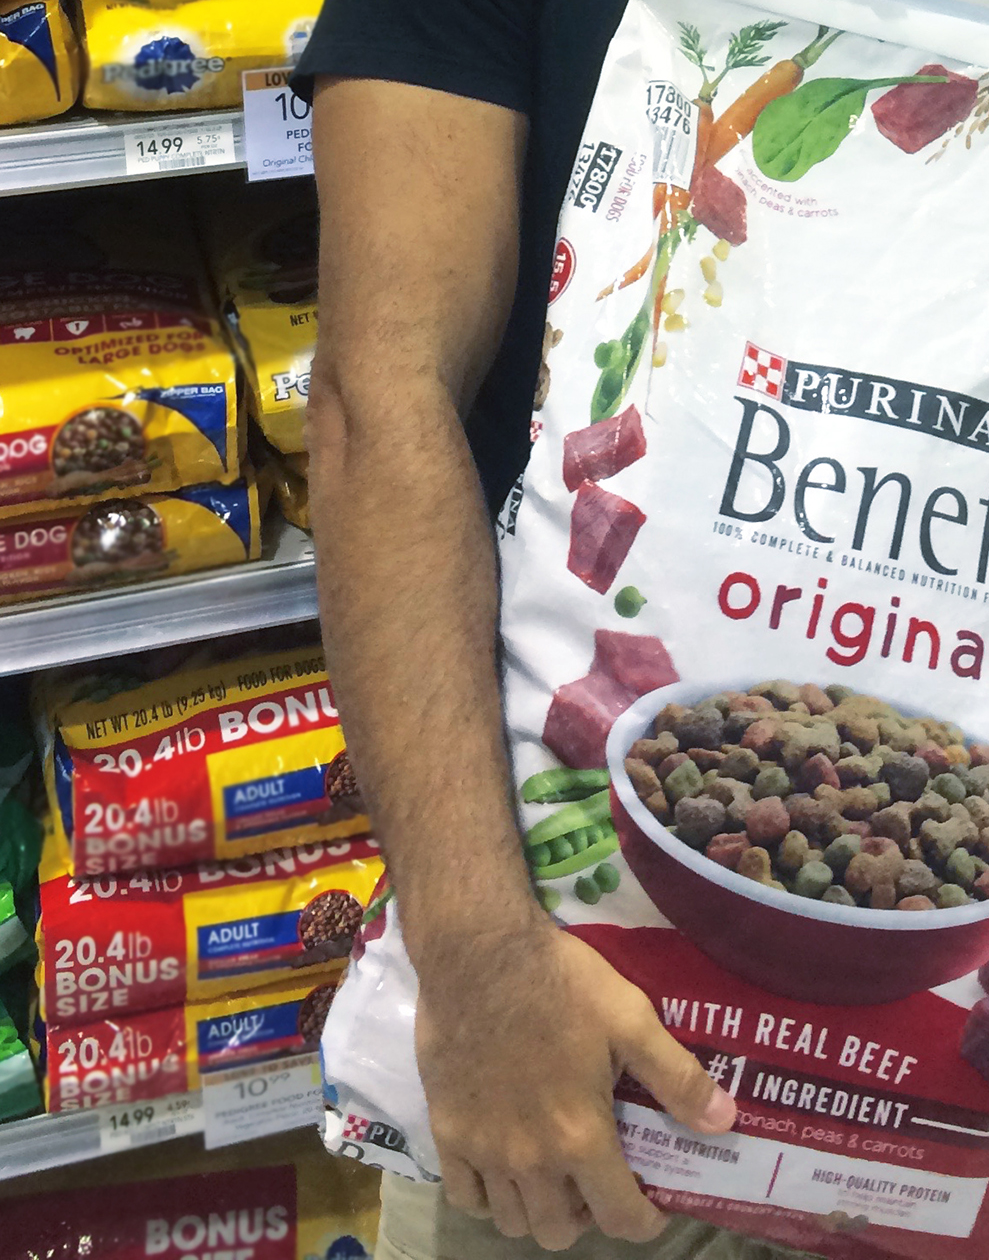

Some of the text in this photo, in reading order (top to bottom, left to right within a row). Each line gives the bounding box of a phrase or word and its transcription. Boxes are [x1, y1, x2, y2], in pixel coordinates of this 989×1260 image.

[646, 84, 692, 118] 17800
[262, 154, 296, 168] Original
[746, 167, 792, 204] accented
[759, 196, 785, 215] peas
[797, 209, 840, 220] carrots
[290, 313, 309, 327] NET
[55, 328, 203, 357] OPTIMIZED FOR
[78, 341, 205, 365] LARGE DOGS
[14, 524, 67, 549] DOG
[712, 520, 744, 541] 100%
[750, 530, 820, 560] COMPLETE
[825, 550, 835, 563] &
[840, 553, 906, 583] BALANCED
[911, 571, 988, 598] NUTRITION
[86, 718, 108, 741] NET
[110, 713, 129, 733] WT
[134, 709, 160, 728] 20.4
[163, 704, 173, 719] lb
[208, 682, 227, 702] kg)
[238, 669, 268, 692] FOOD
[270, 665, 293, 684] FOR
[296, 656, 326, 678] DOGS
[234, 779, 285, 805] ADULT
[84, 819, 207, 855] BONUS
[84, 851, 158, 876] SIZE
[208, 922, 260, 945] ADULT
[56, 957, 180, 997] BONUS
[56, 988, 129, 1017] SIZE
[208, 1016, 260, 1038] ADULT
[661, 996, 919, 1085] WITH REAL BEEF
[59, 1053, 180, 1099] BONUS
[59, 1087, 132, 1112] SIZE
[751, 1071, 910, 1130] INGREDIENT
[674, 1135, 741, 1165] NUTRITION
[801, 1124, 844, 1147] peas
[862, 1138, 926, 1162] carrots
[811, 1166, 897, 1197] HIGH-QUALITY
[900, 1182, 952, 1205] PROTEIN
[145, 1205, 289, 1255] BONUS
